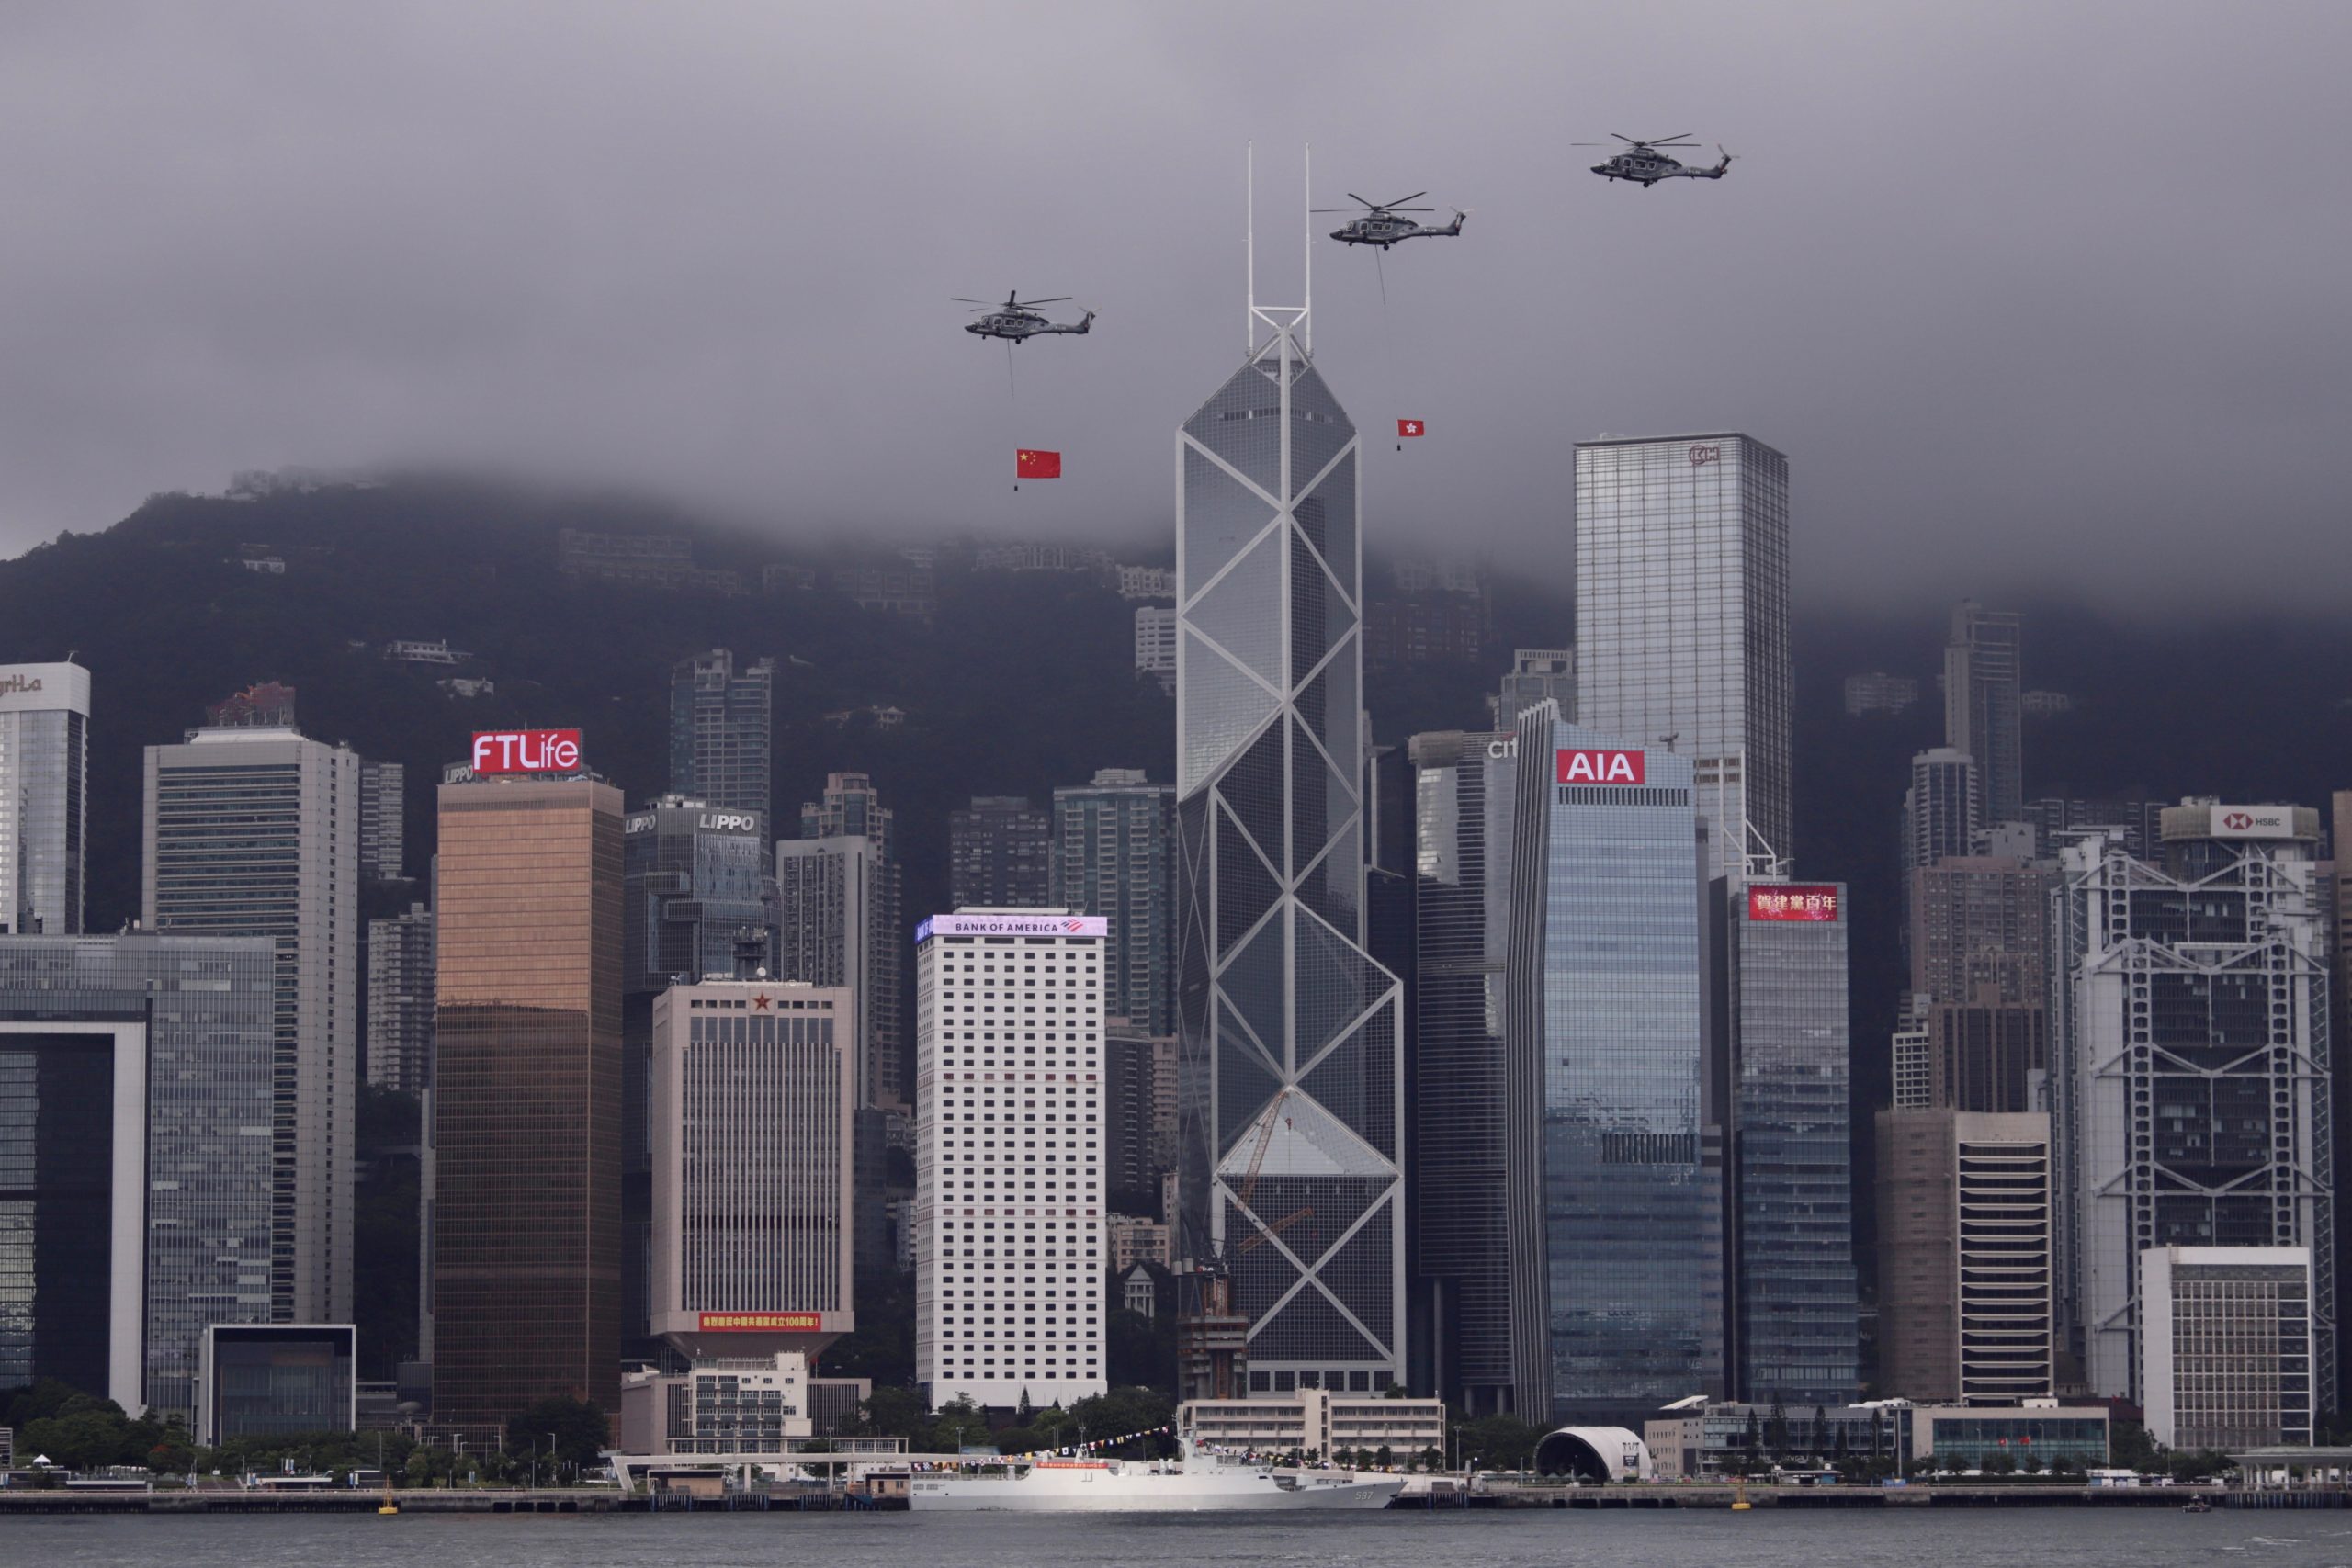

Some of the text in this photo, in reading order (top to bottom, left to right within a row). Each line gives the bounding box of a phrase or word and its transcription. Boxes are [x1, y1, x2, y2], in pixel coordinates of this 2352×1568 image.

[474, 734, 579, 770] FTLife
[445, 764, 473, 784] LIPPO
[1566, 752, 1635, 781] AIA
[625, 814, 657, 834] LIPPO
[699, 813, 755, 831] LIPPO
[2256, 818, 2281, 827] HSBC
[1756, 894, 1837, 911] 賀建黨百年
[956, 922, 1058, 932] BANK OF AMERICA
